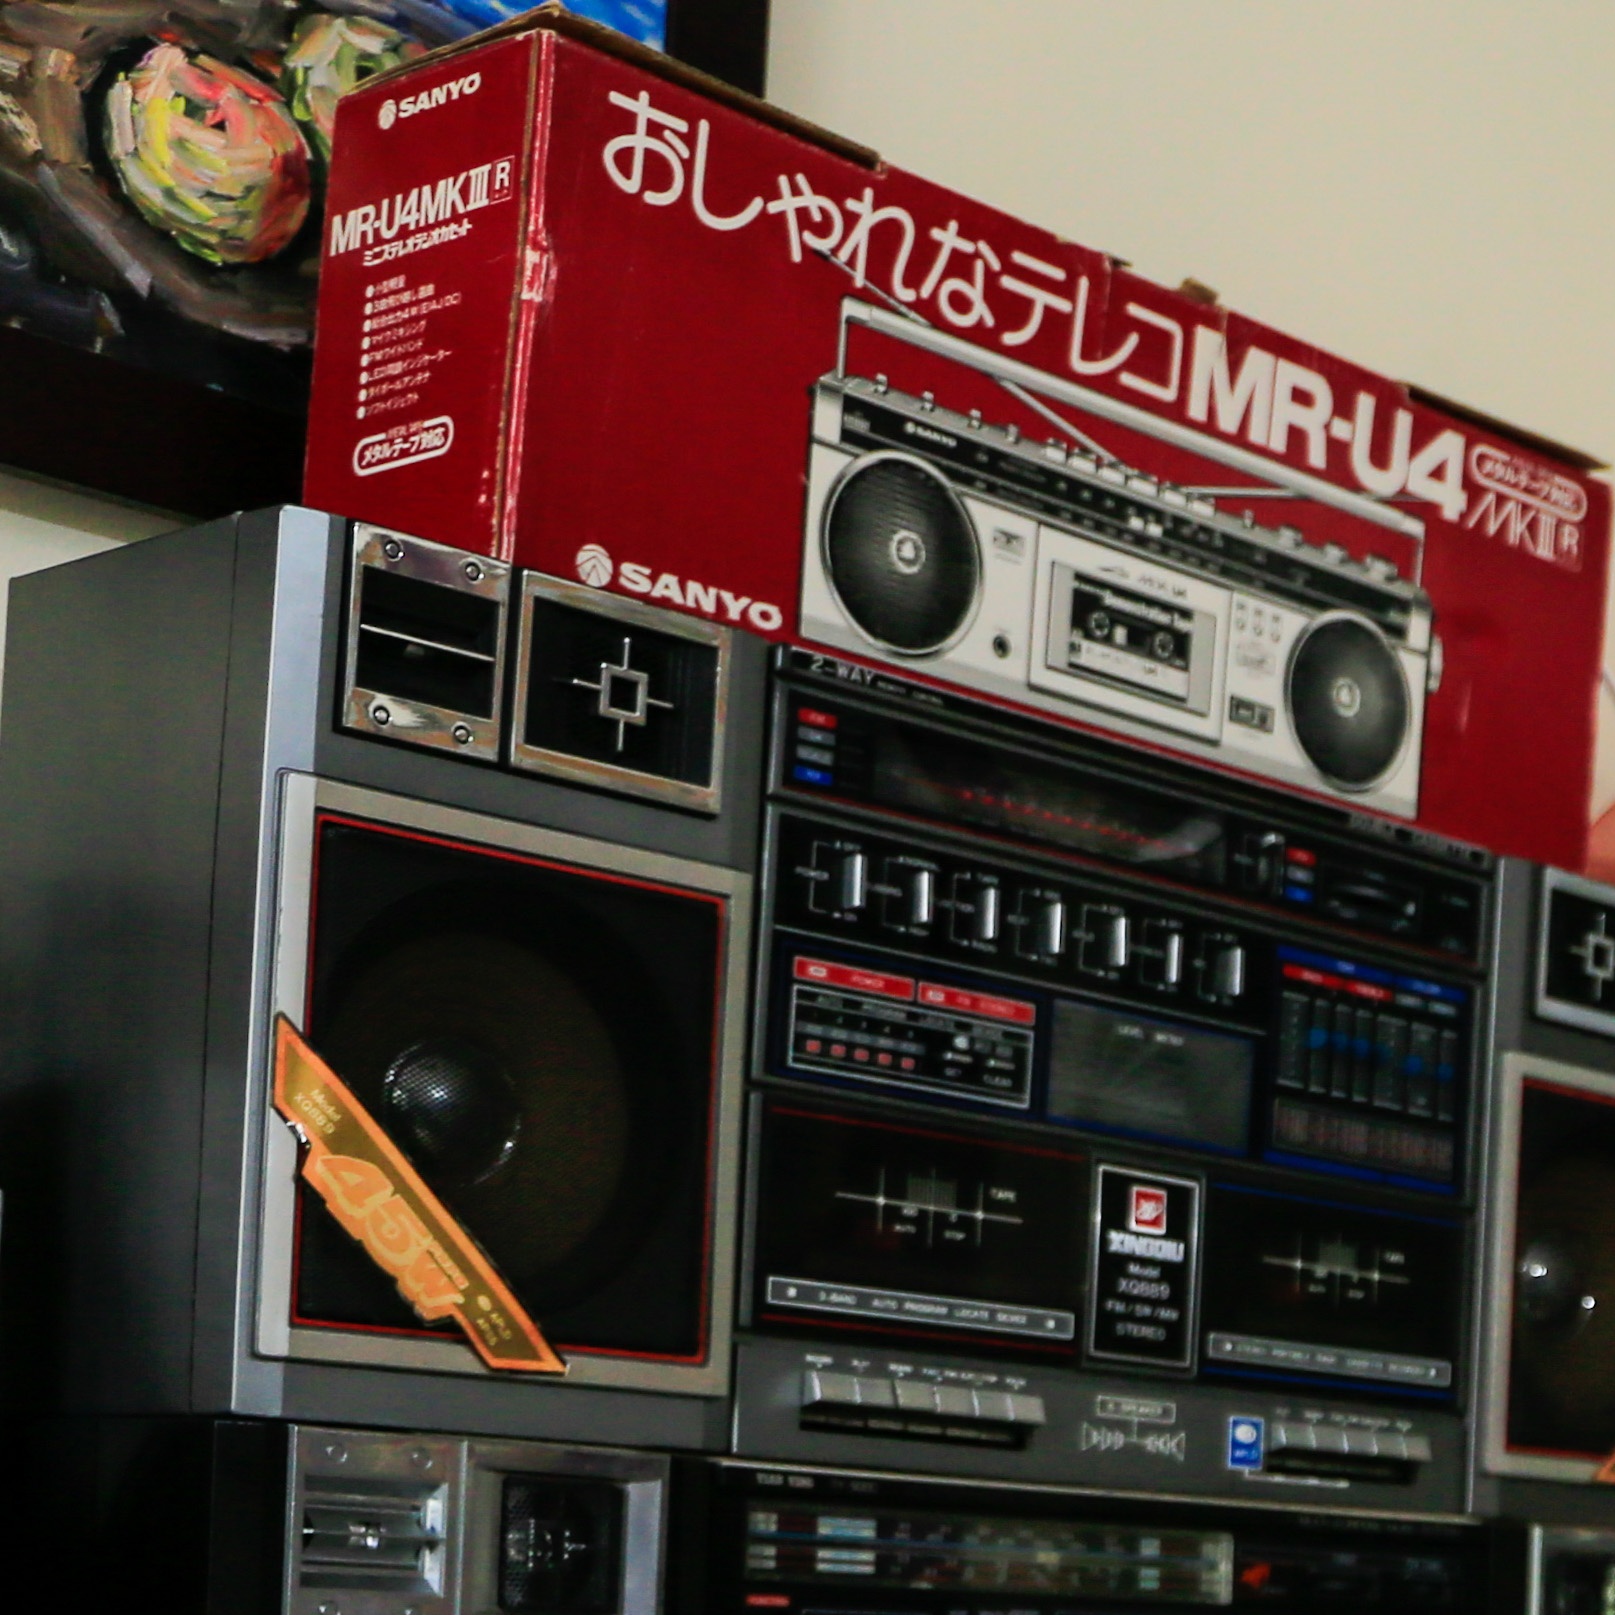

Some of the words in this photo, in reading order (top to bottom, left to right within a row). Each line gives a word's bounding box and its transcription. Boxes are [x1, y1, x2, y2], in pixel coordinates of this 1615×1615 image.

[398, 72, 482, 118] SANYO
[603, 91, 1184, 402] おしゃれなテレコ
[1186, 325, 1467, 522] MR-U4
[620, 565, 783, 631] SANYO
